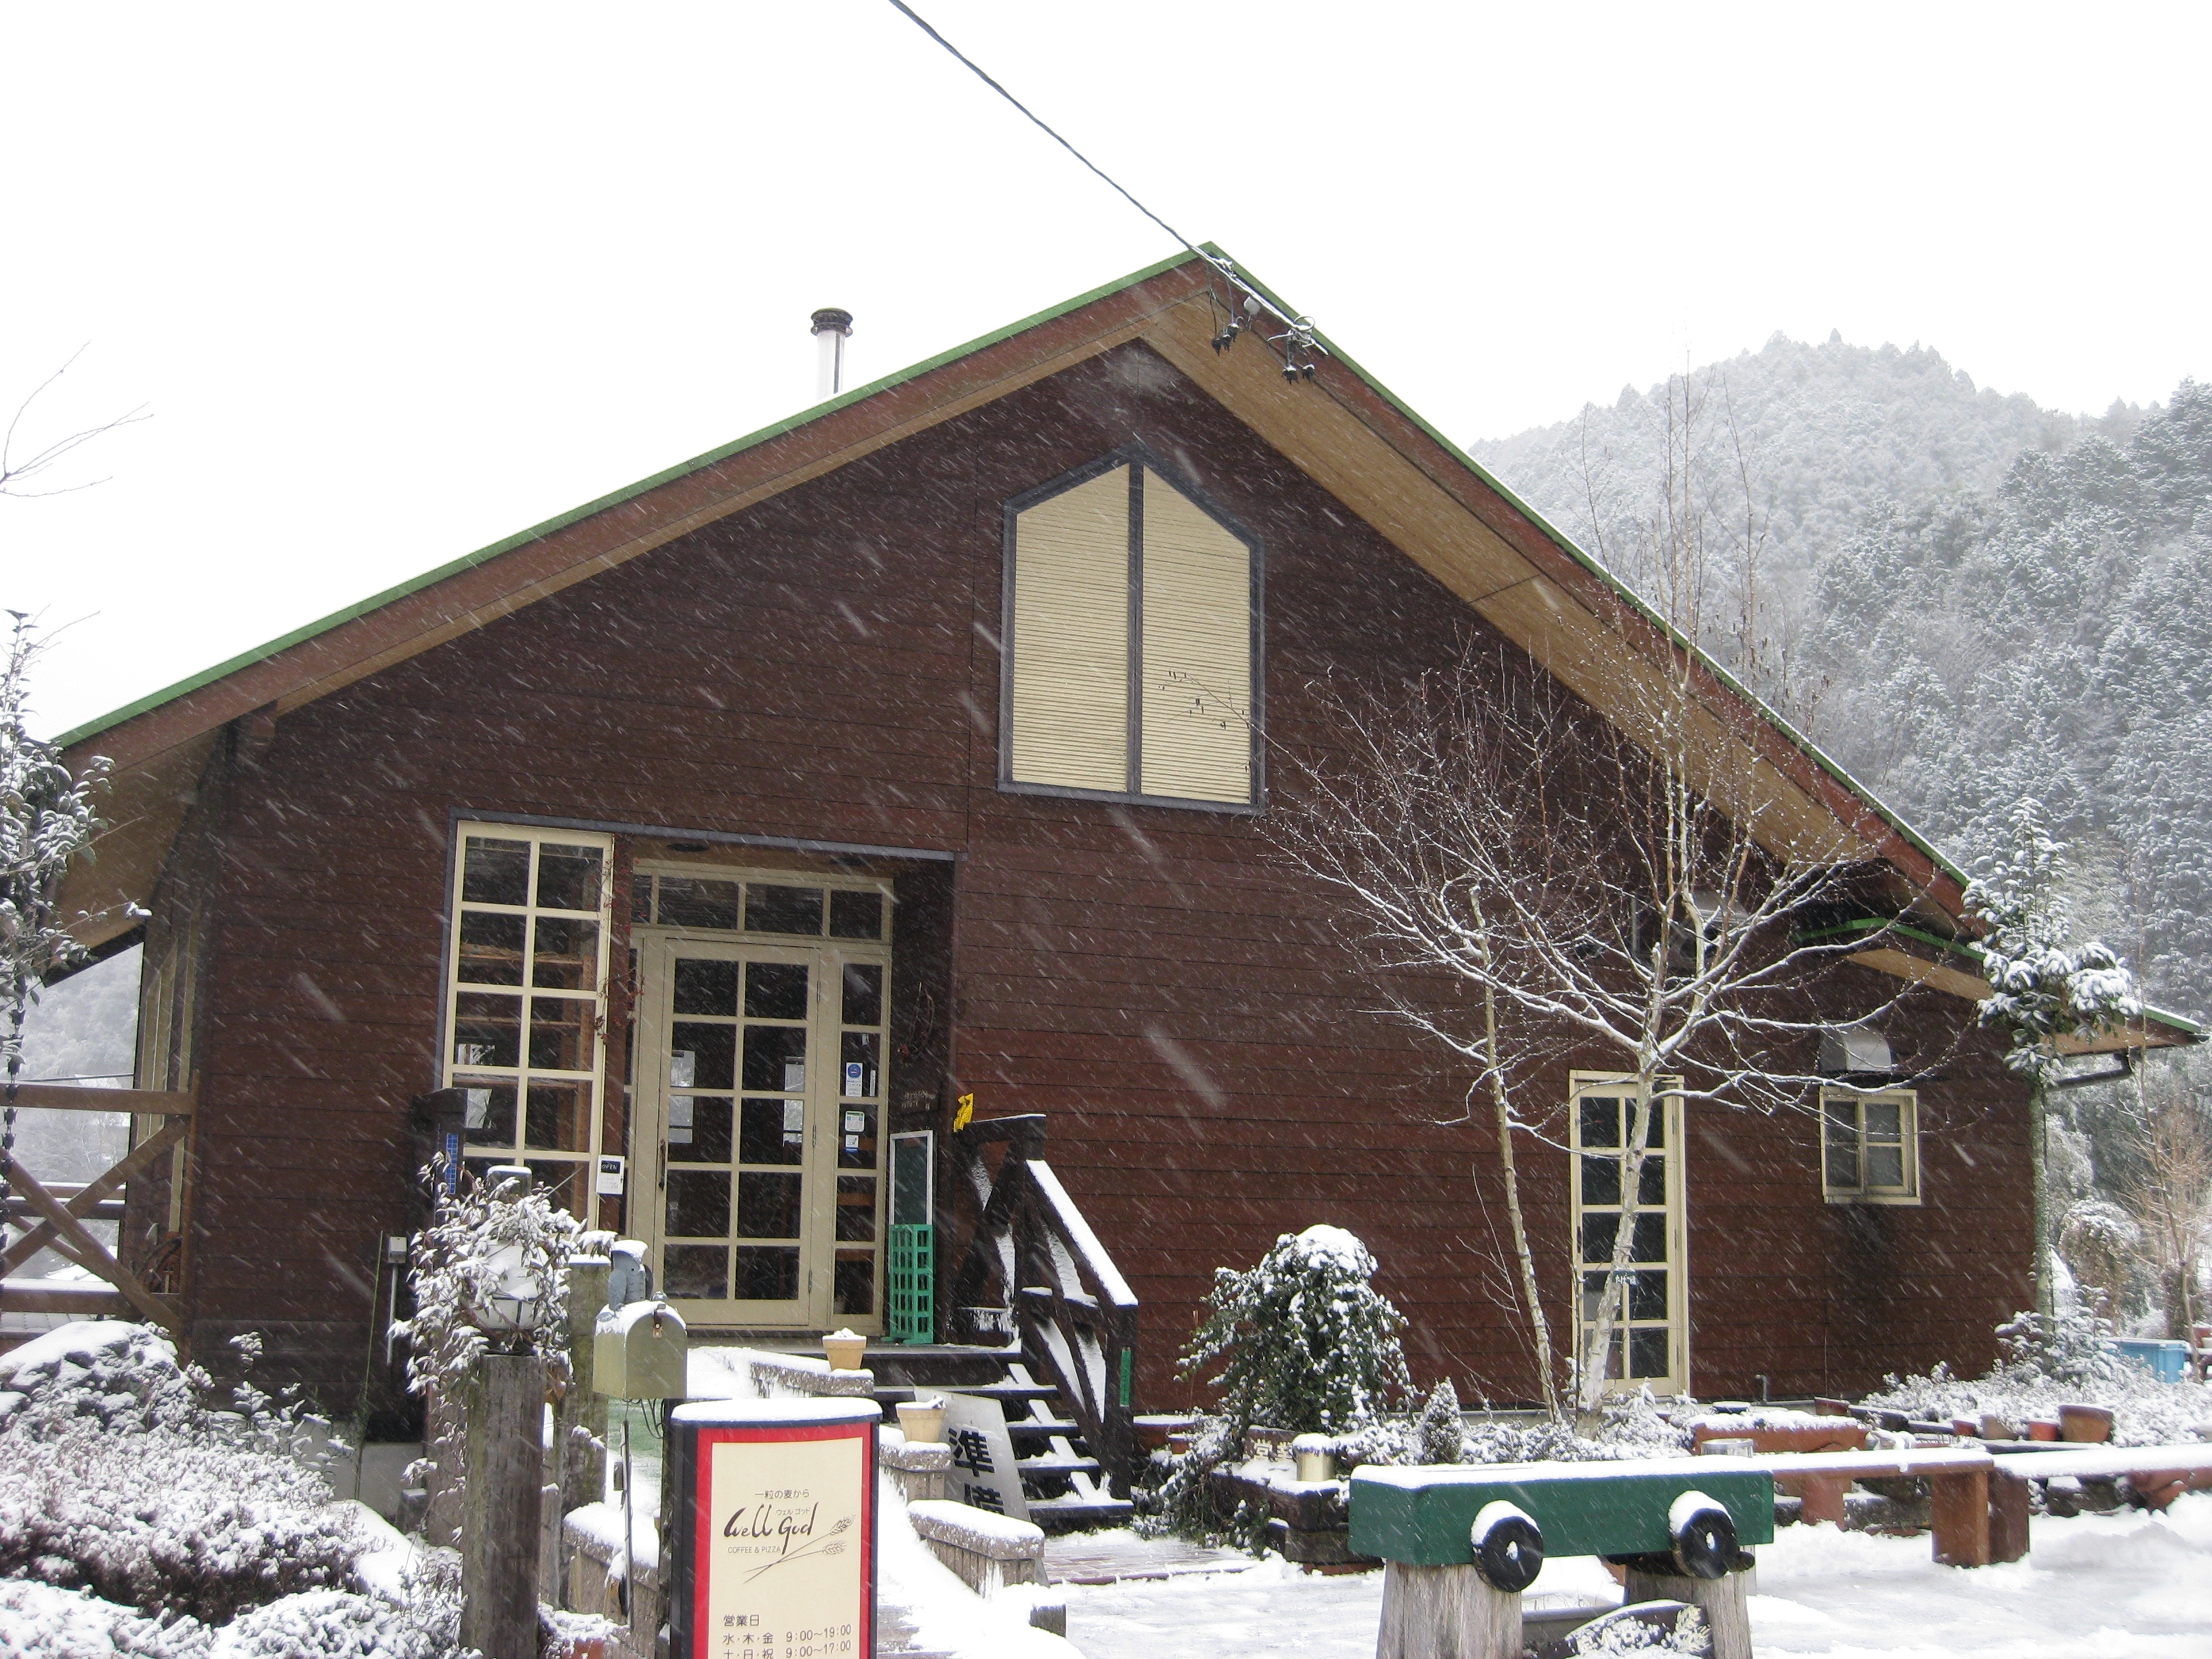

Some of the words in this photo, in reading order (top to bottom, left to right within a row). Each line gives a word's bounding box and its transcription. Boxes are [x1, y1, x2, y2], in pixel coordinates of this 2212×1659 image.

[754, 1488, 810, 1499] 一粒の麦から
[727, 1546, 753, 1554] COFFEE
[723, 1614, 760, 1627] 営業日
